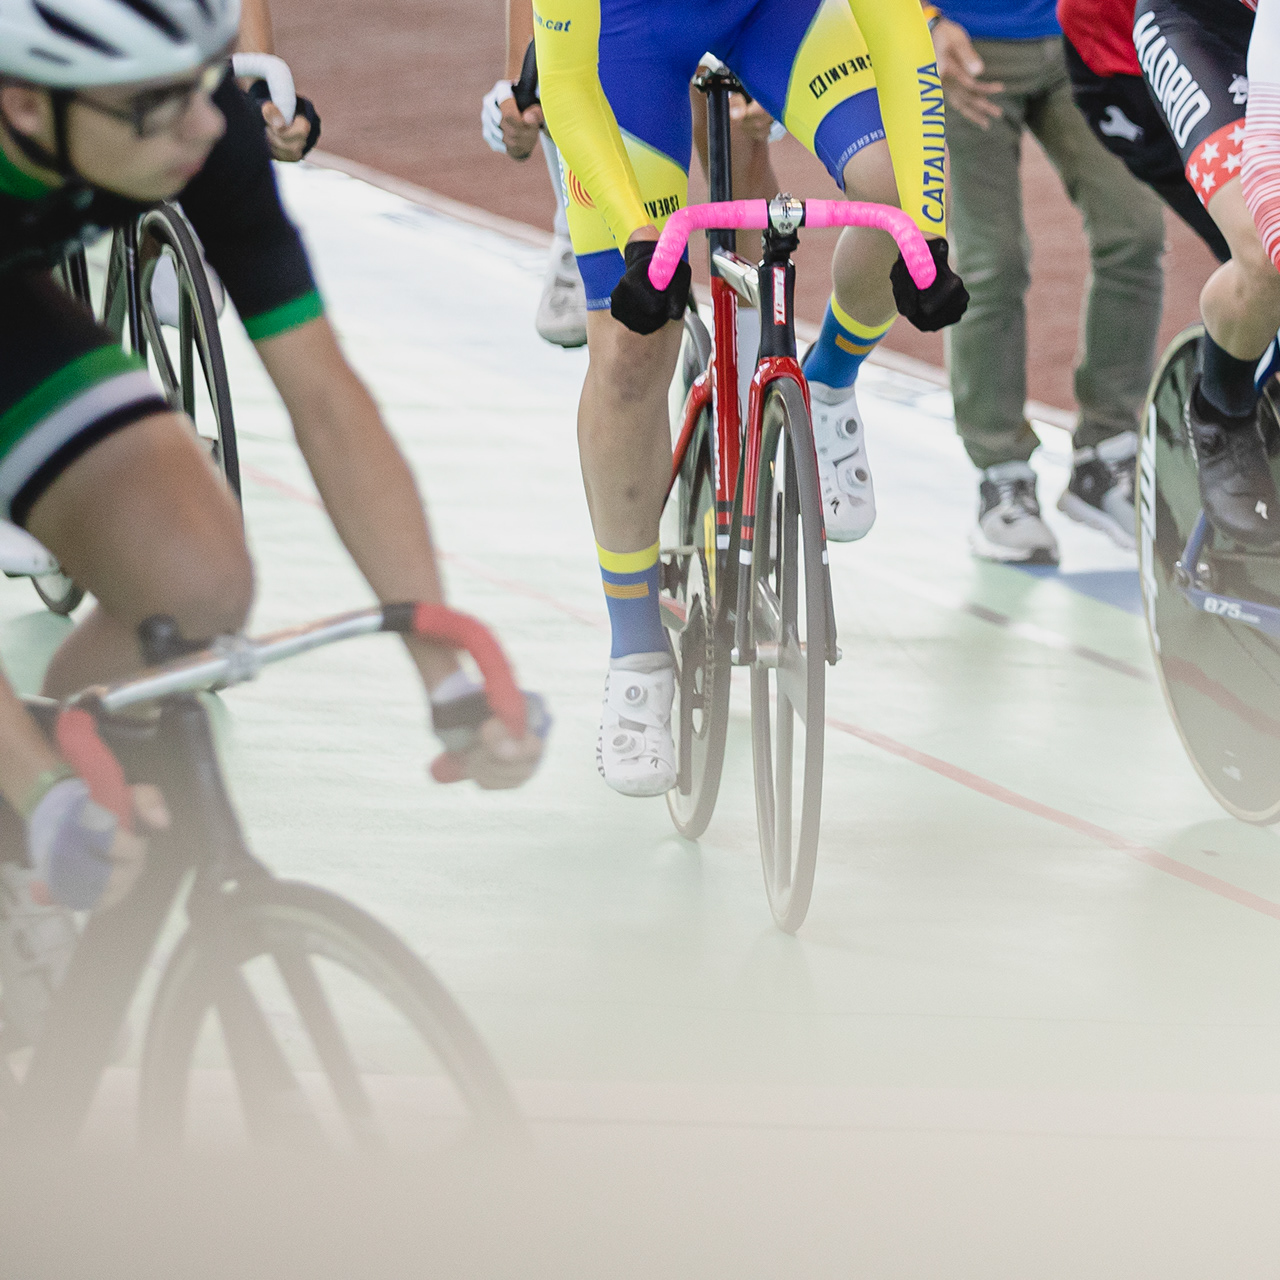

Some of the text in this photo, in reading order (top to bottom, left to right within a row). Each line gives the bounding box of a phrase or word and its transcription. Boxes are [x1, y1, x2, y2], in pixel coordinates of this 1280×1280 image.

[826, 54, 873, 86] INVERS
[1132, 10, 1211, 149] MADRID
[916, 61, 945, 224] CATALUNYA
